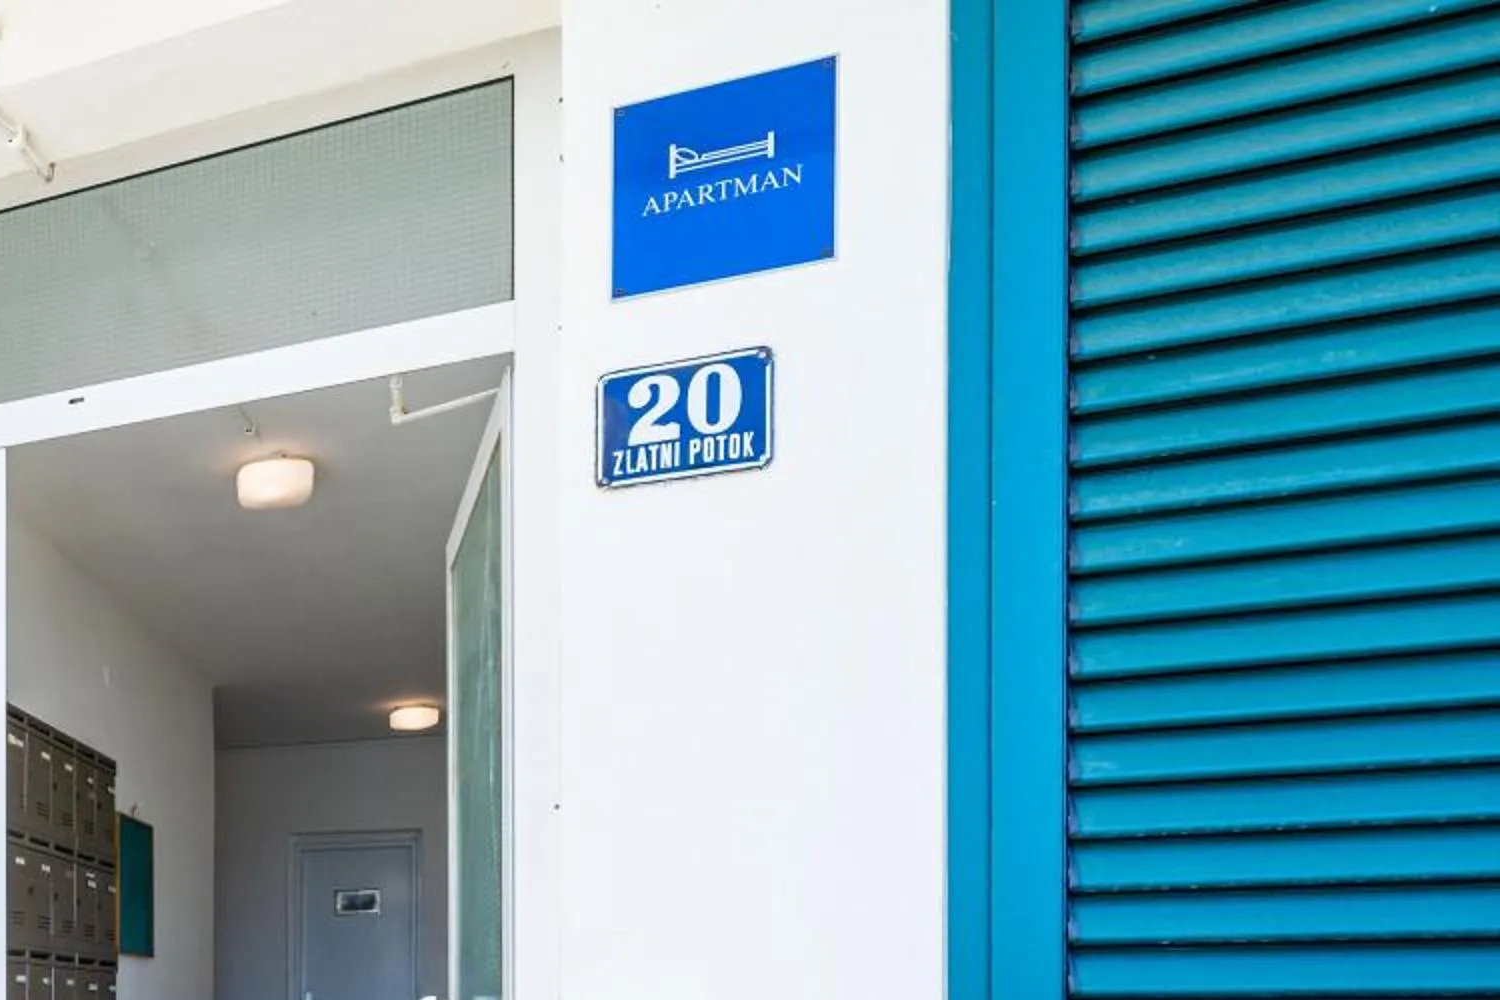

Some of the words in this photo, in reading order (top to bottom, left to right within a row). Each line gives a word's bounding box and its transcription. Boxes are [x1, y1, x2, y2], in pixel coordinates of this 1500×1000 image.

[642, 163, 804, 217] APARTMAN
[627, 362, 743, 447] 20
[612, 441, 682, 477] ZLATNI
[688, 430, 756, 466] POTOK
